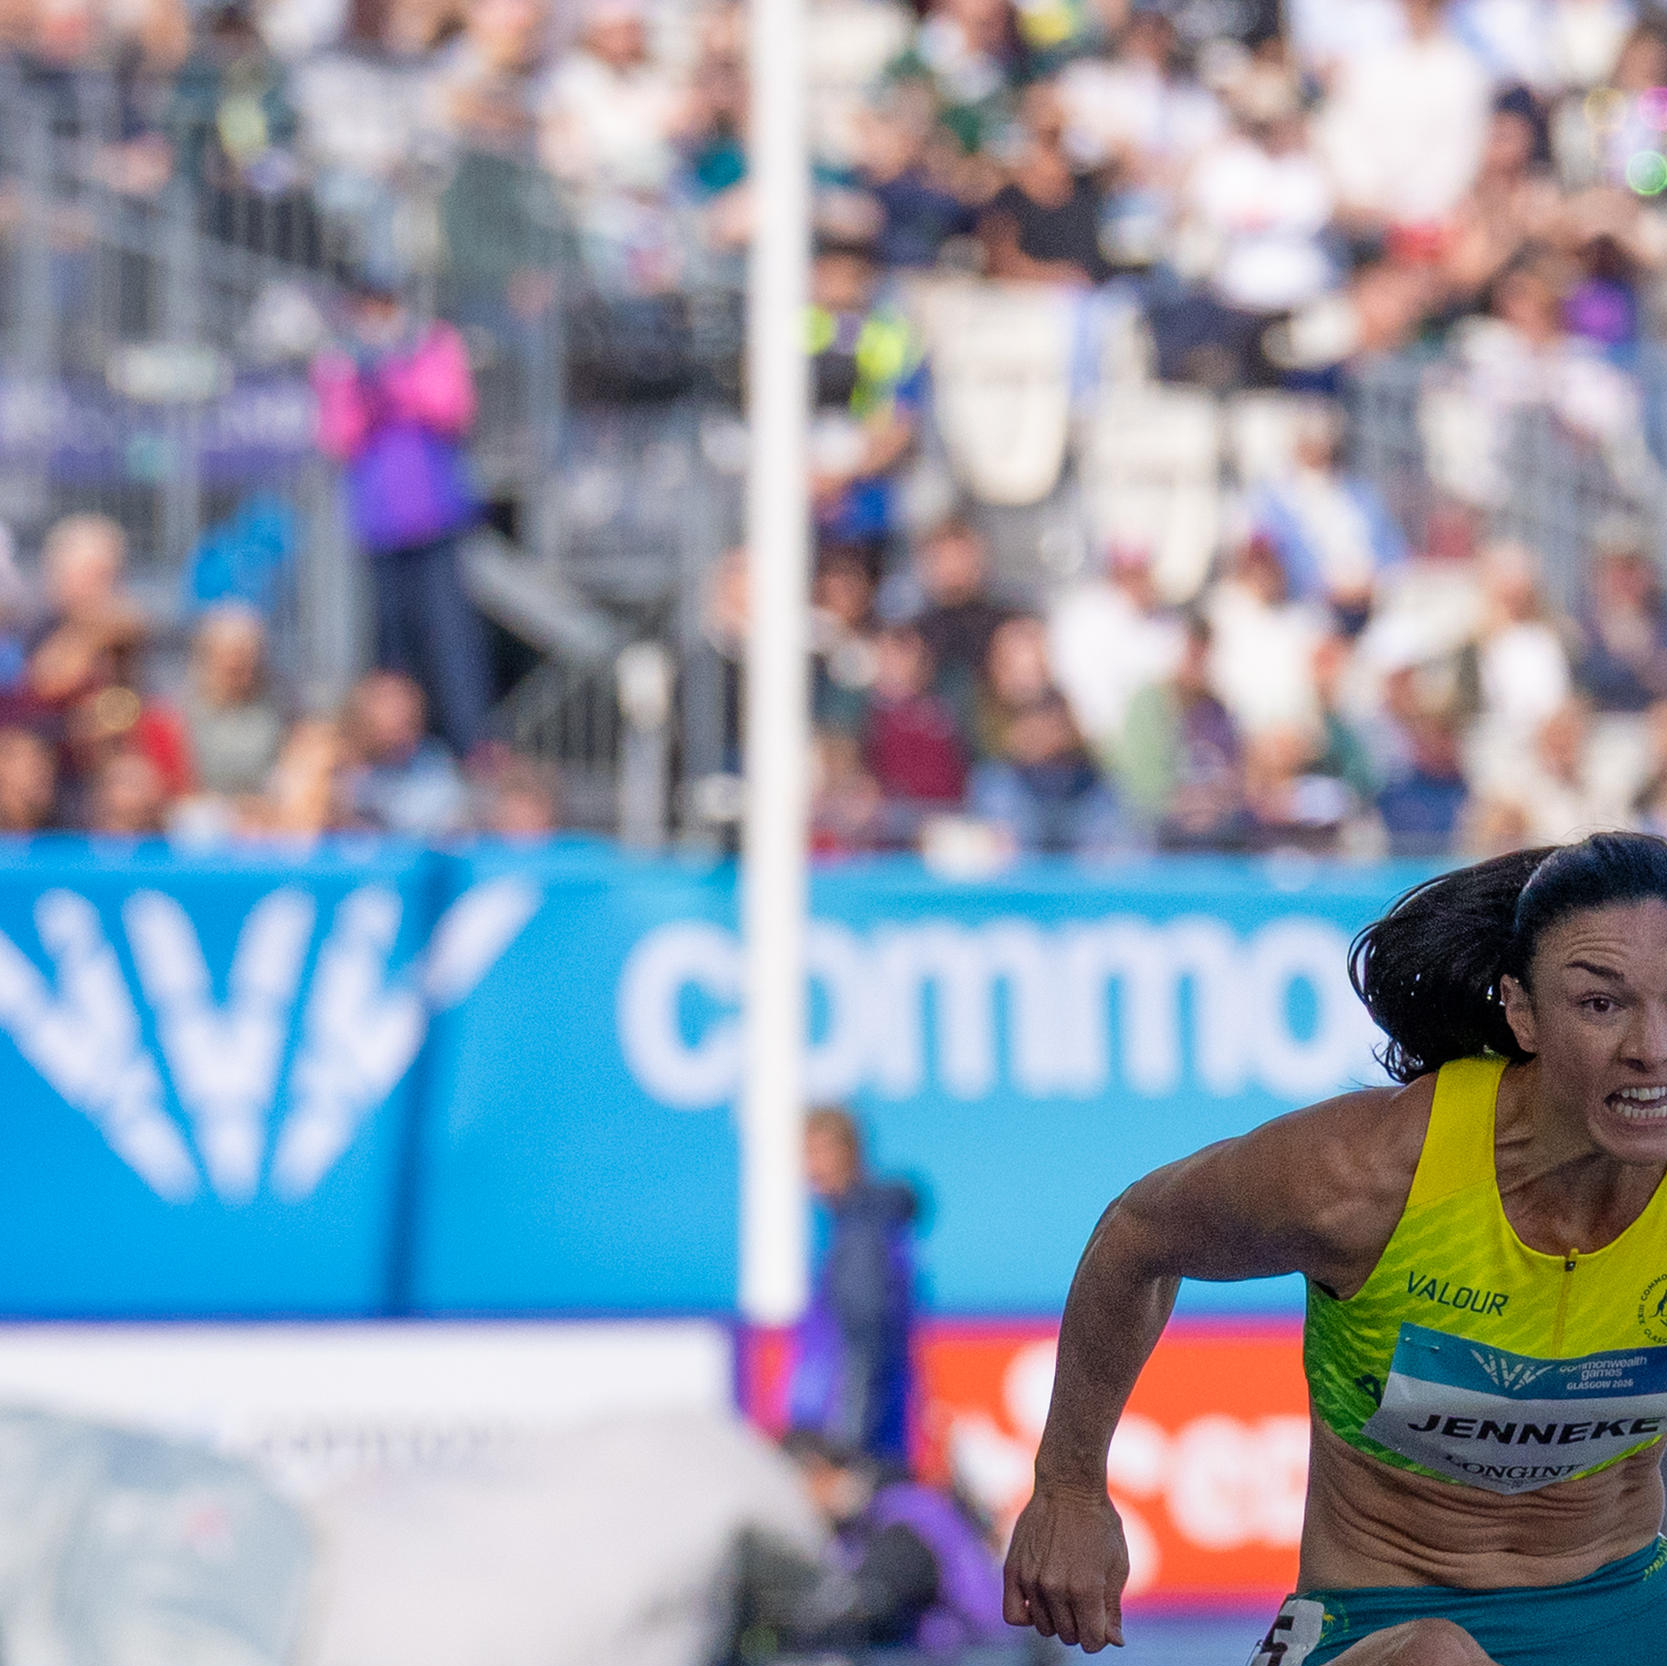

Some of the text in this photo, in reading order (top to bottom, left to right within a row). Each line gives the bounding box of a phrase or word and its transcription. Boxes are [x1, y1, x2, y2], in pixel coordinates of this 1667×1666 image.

[1408, 1270, 1509, 1317] VALOUR
[1560, 1356, 1648, 1373] commonwealth
[1581, 1368, 1622, 1381] games
[1566, 1380, 1612, 1391] GLASGOW
[1408, 1414, 1666, 1446] JENNEKE
